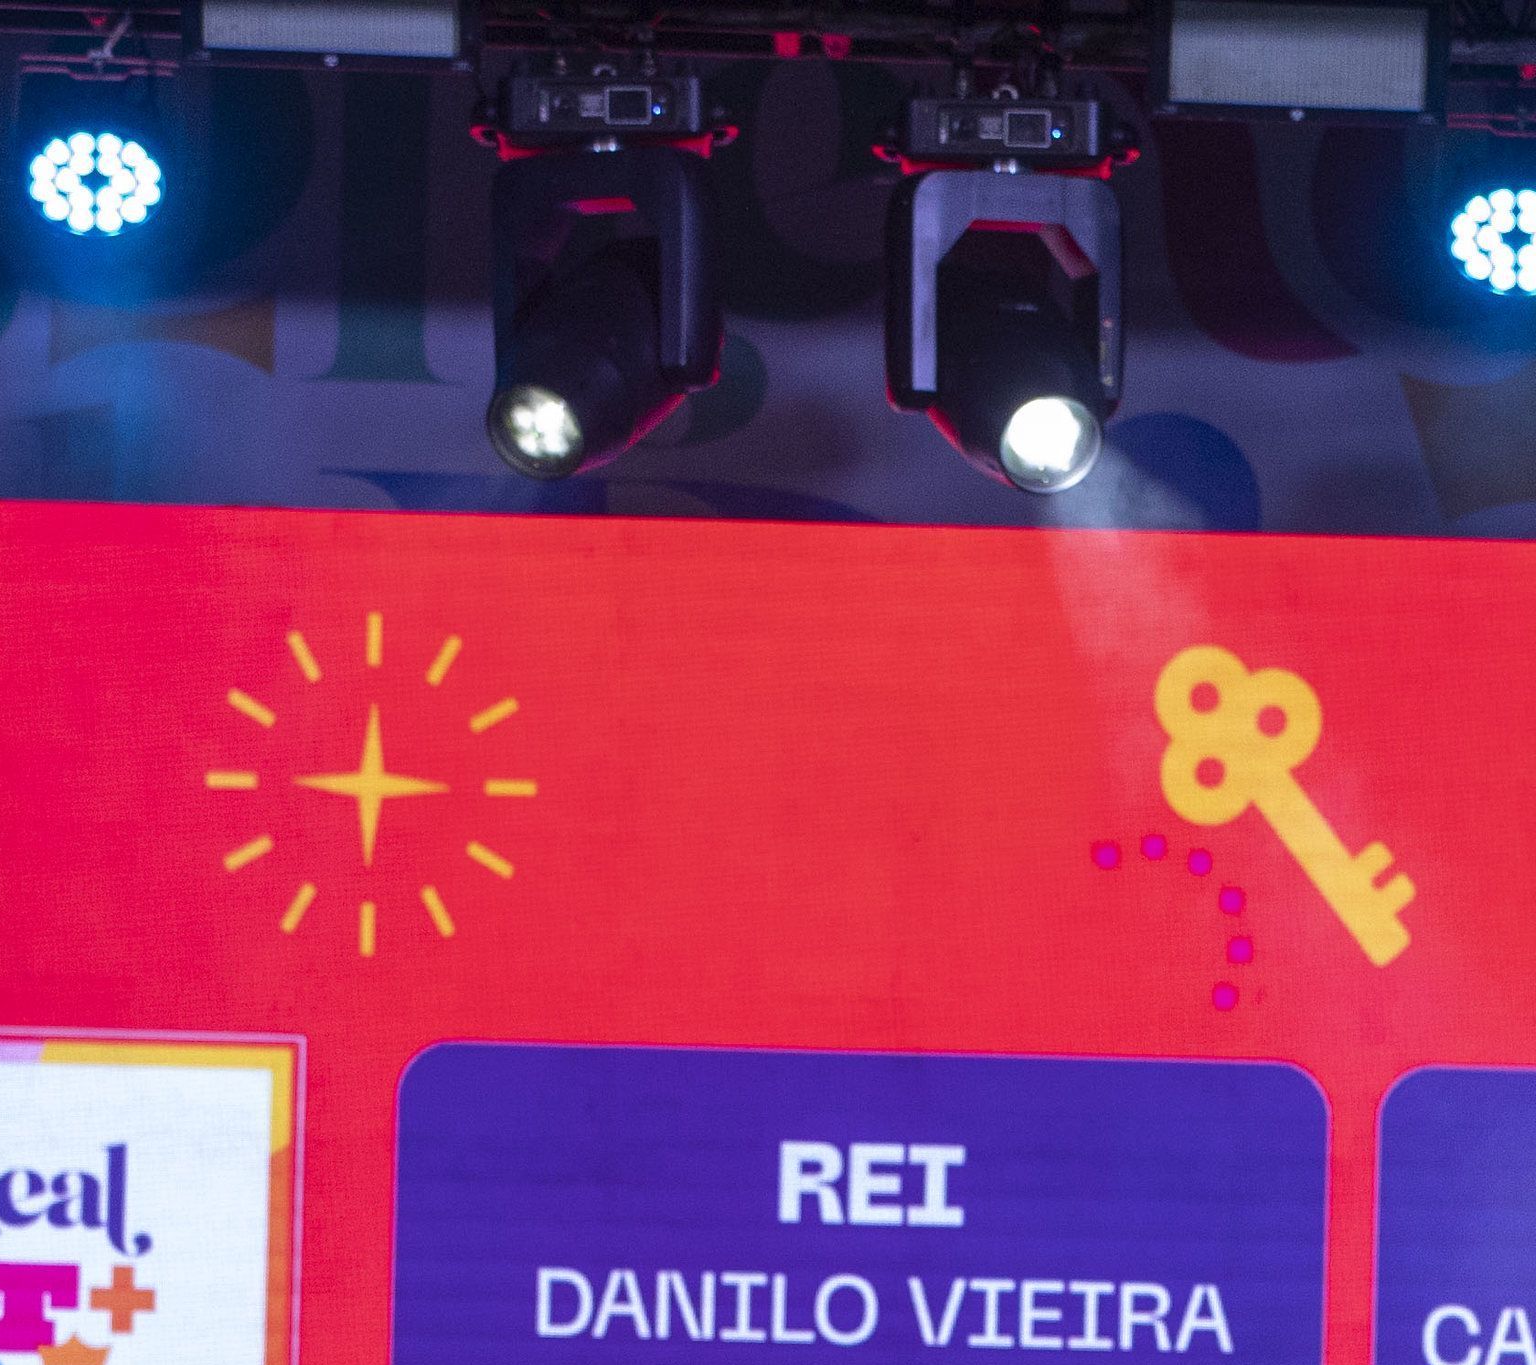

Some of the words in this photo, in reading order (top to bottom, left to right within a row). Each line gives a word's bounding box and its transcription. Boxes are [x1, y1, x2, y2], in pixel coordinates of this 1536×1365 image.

[777, 1140, 966, 1227] REI
[535, 1266, 879, 1346] DANILO
[907, 1276, 1234, 1354] VIEIRA
